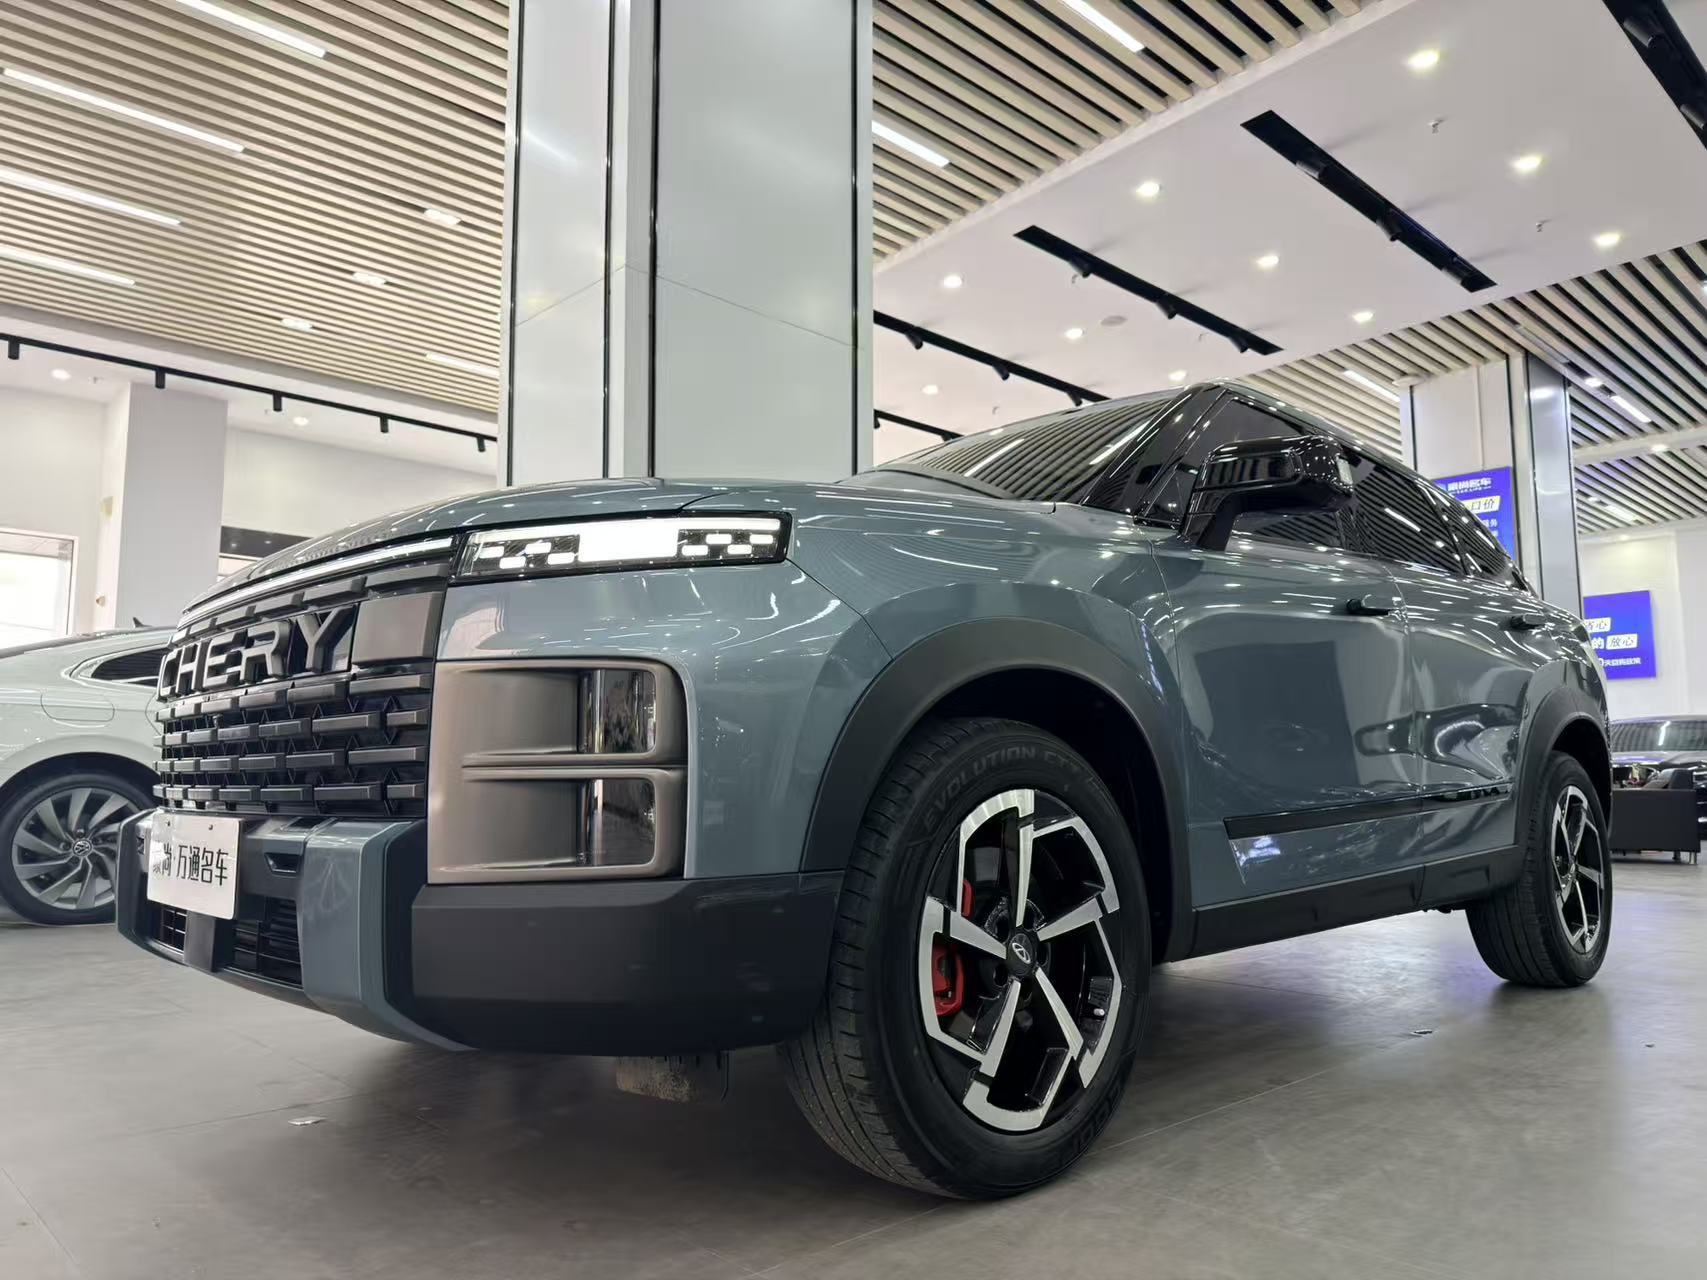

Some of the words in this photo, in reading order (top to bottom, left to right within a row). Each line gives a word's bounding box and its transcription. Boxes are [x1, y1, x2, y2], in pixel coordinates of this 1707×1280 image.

[157, 605, 354, 701] CHERY
[1609, 636, 1635, 648] 放心
[923, 745, 1036, 833] EVOLUTION
